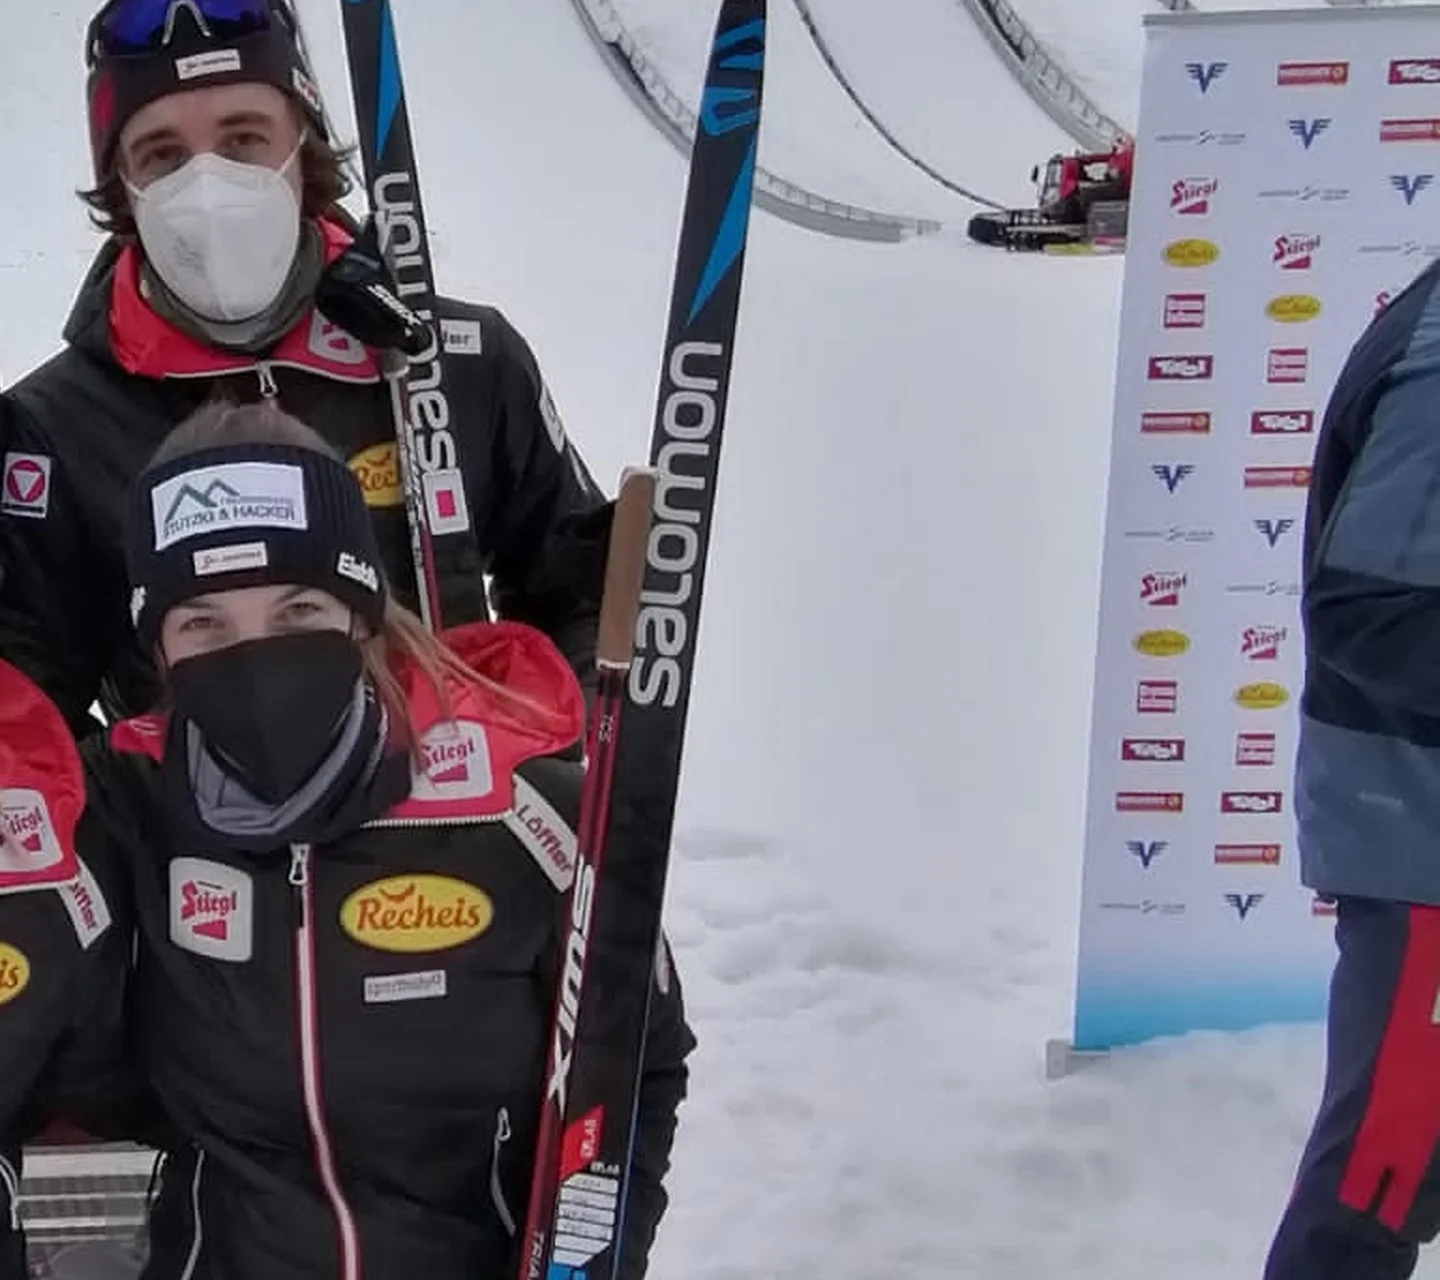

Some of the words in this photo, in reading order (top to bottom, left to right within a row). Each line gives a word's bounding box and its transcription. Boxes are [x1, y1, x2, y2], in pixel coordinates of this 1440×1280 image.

[629, 339, 723, 709] salomon
[516, 803, 574, 874] Löffler
[180, 880, 238, 920] Stiegl
[356, 897, 482, 933] Recheis
